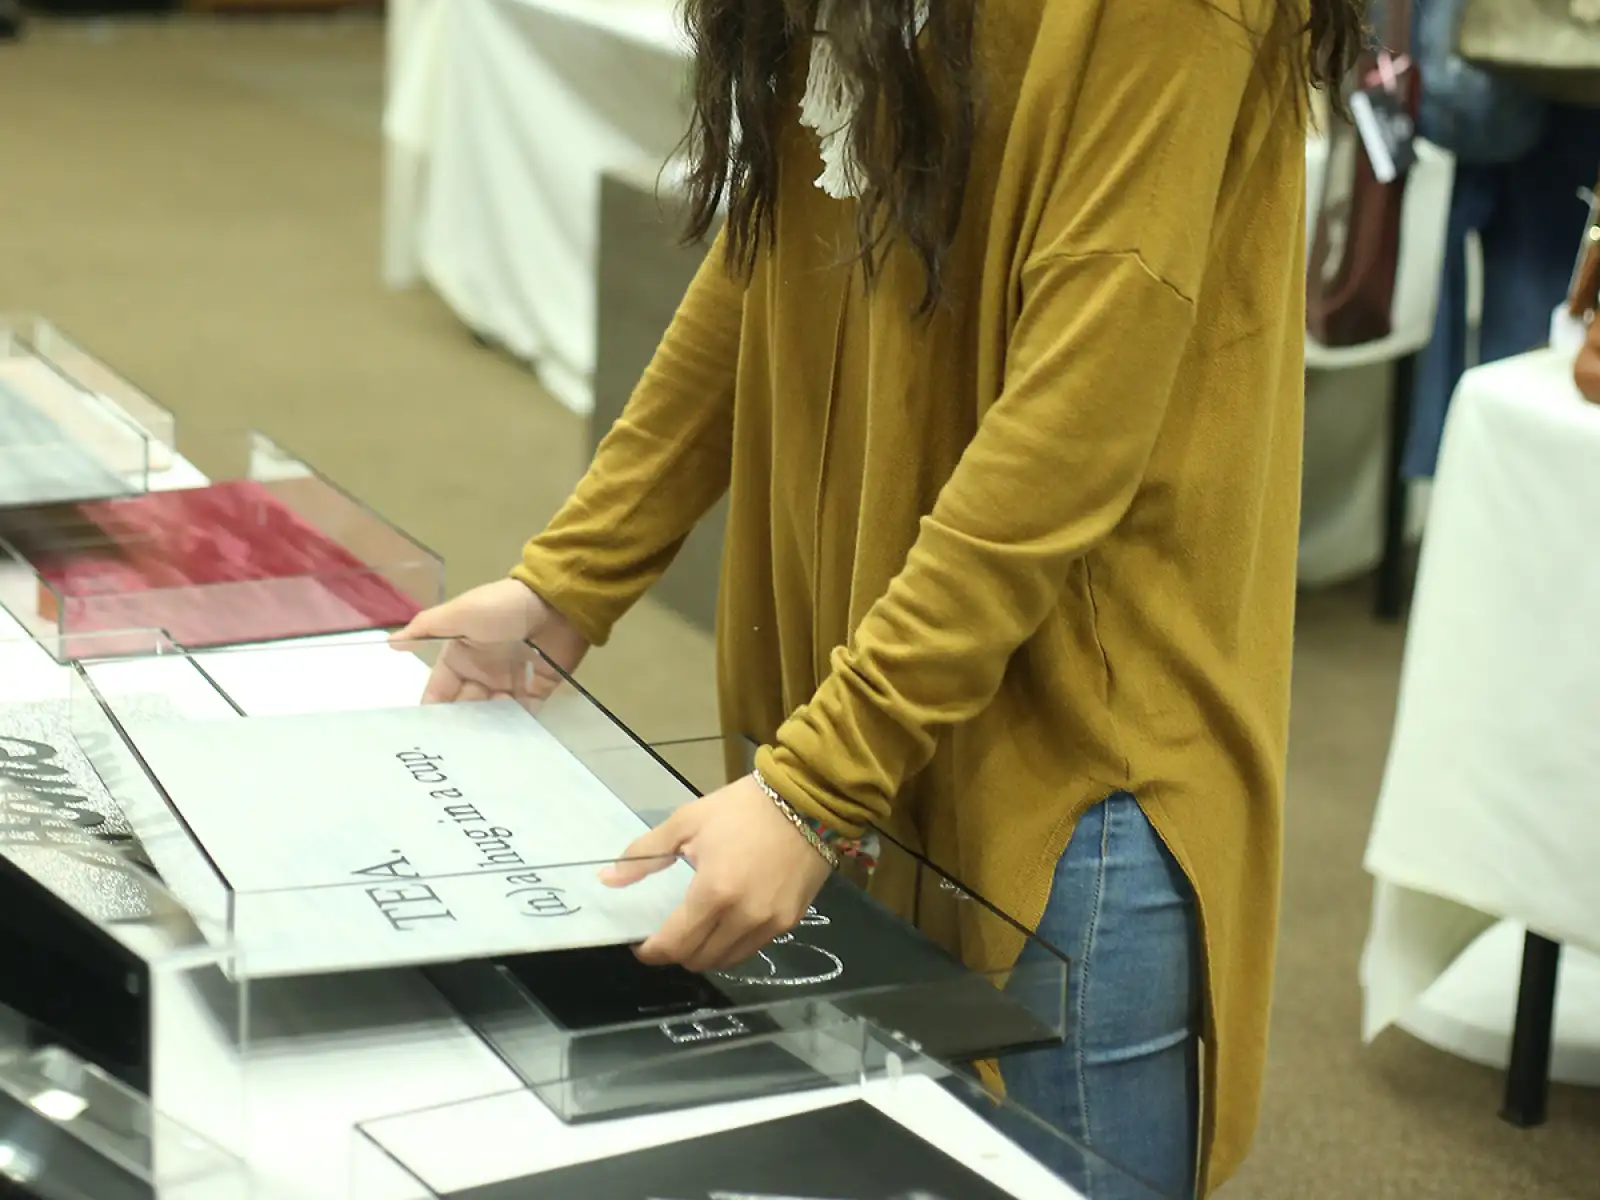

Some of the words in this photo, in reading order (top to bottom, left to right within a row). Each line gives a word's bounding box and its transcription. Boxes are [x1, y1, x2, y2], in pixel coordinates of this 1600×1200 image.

[395, 746, 447, 784] cup.
[429, 787, 463, 799] a
[437, 803, 486, 824] in
[462, 825, 526, 869] hug
[349, 849, 457, 932] TEA.
[506, 871, 542, 886] a
